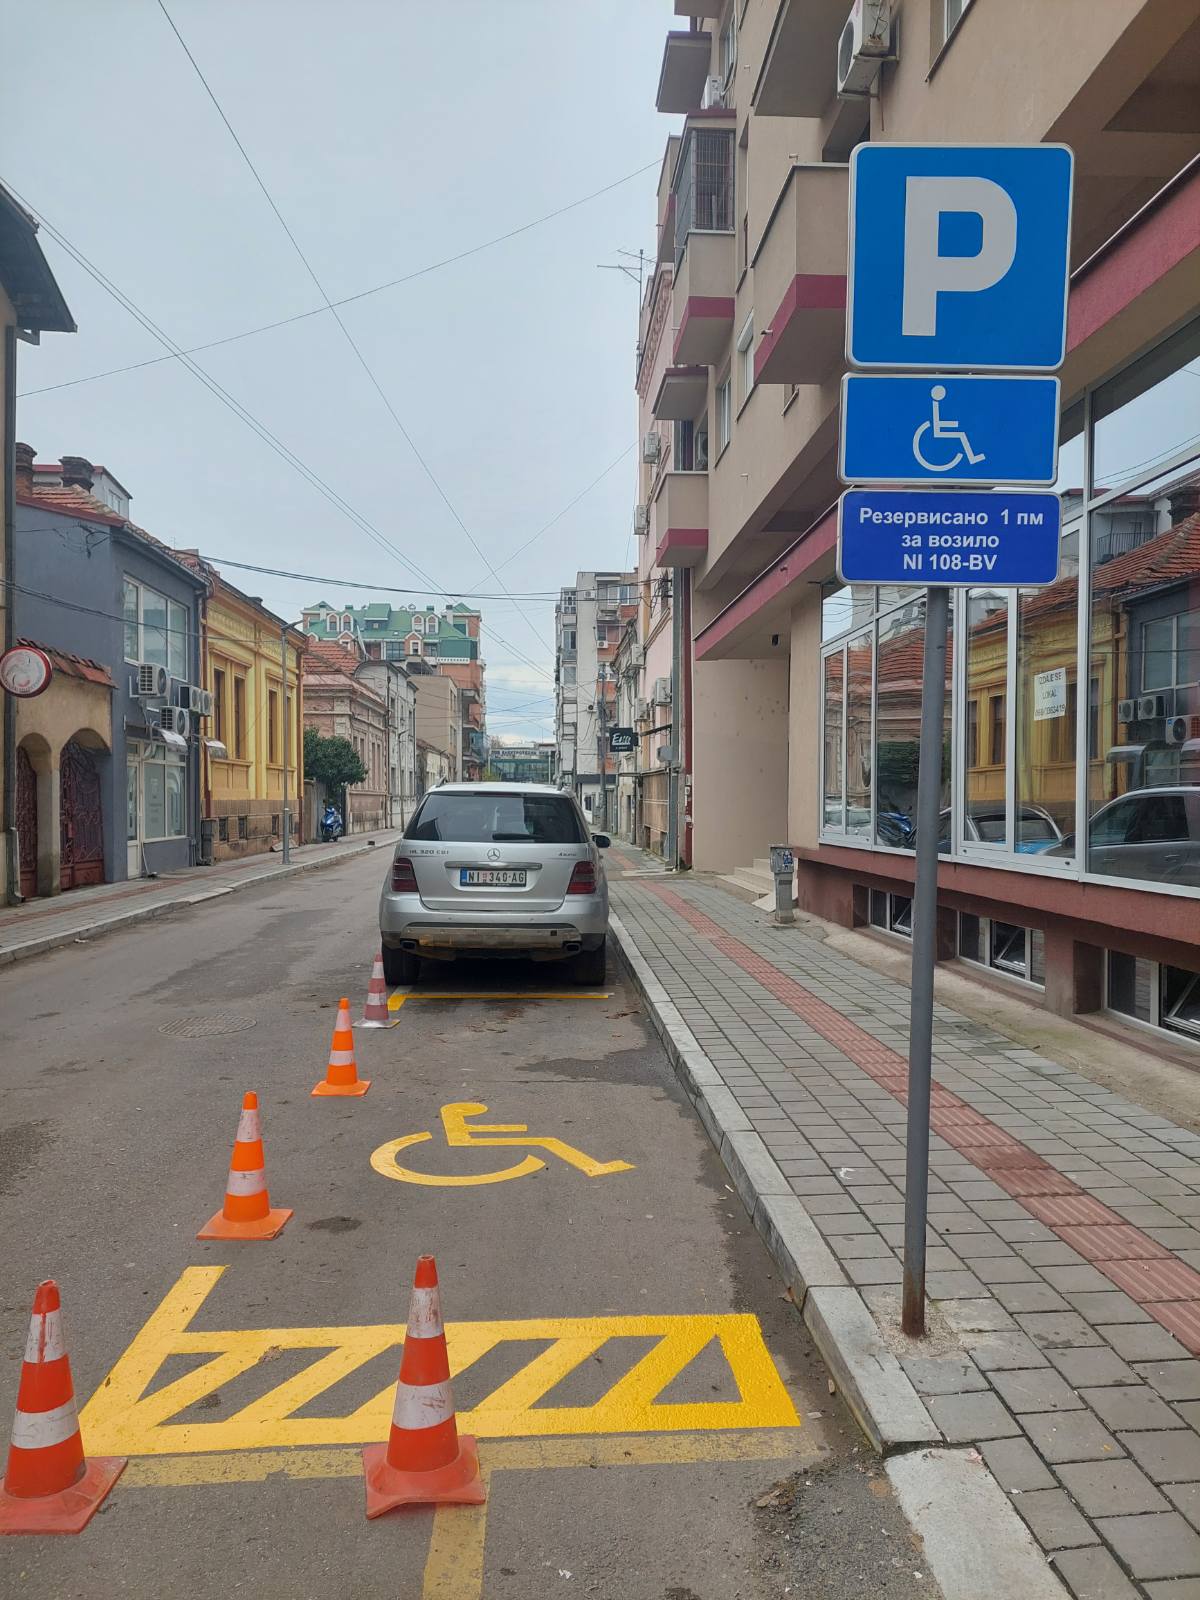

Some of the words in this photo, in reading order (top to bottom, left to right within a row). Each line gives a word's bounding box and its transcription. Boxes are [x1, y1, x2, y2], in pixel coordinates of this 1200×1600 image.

[902, 176, 1018, 336] P
[859, 507, 989, 528] Резервисано
[1000, 508, 1009, 525] 1
[1016, 512, 1044, 525] пм
[901, 534, 922, 547] за
[928, 535, 1000, 548] возило
[903, 553, 923, 570] NI
[929, 554, 998, 571] 108-BV
[468, 871, 480, 882] NI
